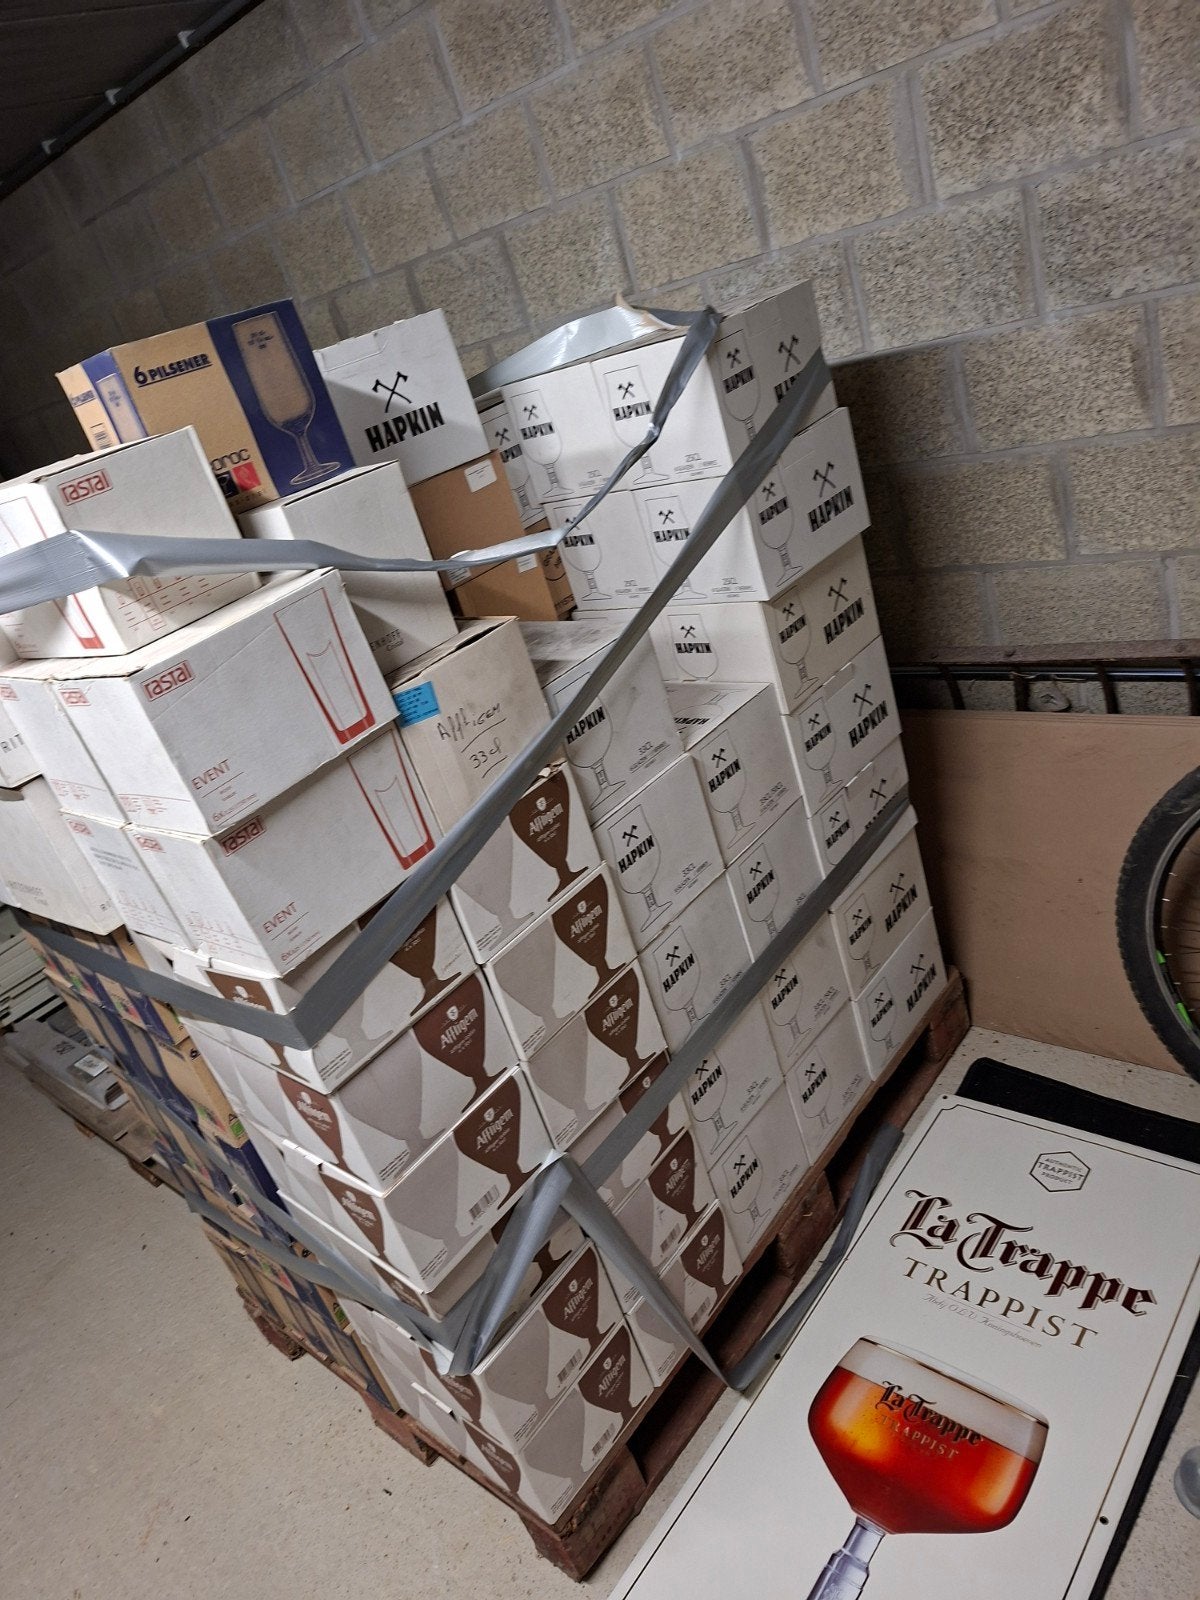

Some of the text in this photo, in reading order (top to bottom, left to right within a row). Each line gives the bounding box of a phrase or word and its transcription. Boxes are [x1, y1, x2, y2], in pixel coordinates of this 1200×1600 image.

[133, 354, 210, 385] 6 PILSENER
[365, 402, 445, 452] HAPKIN
[521, 422, 556, 440] HAPKIN
[62, 470, 110, 504] rastal
[808, 485, 855, 532] HAPKIN
[653, 528, 691, 543] HAPKIN
[823, 598, 865, 645] HAPKIN
[675, 643, 713, 654] HAPKIN
[144, 662, 192, 699] rastal
[566, 706, 606, 745] HAPKIN
[804, 723, 833, 752] HAPKIN
[848, 700, 889, 748] HAPKIN
[192, 759, 231, 790] EVENT
[708, 758, 742, 794] HAPKIN
[220, 817, 265, 853] rastal
[617, 835, 655, 874] HAPKIN
[746, 870, 775, 904] HAPKIN
[263, 902, 298, 933] EVENT
[885, 884, 918, 933] HAPKIN
[662, 953, 696, 993] HAPKIN
[771, 974, 799, 1010] HAPKIN
[906, 963, 937, 1013] HAPKIN
[440, 1008, 479, 1050] Affligem
[691, 1065, 723, 1106] HAPKIN
[802, 1068, 828, 1104] HAPKIN
[476, 1108, 515, 1150] Affligem
[730, 1158, 759, 1199] HAPKIN
[1038, 1161, 1085, 1181] TRAPPIST
[889, 1189, 1158, 1317] La Trappe
[563, 1278, 594, 1320] Affligem
[903, 1256, 1099, 1349] TRAPPIST
[875, 1380, 984, 1446] La Trappe
[881, 1414, 960, 1459] TRAPPIST
